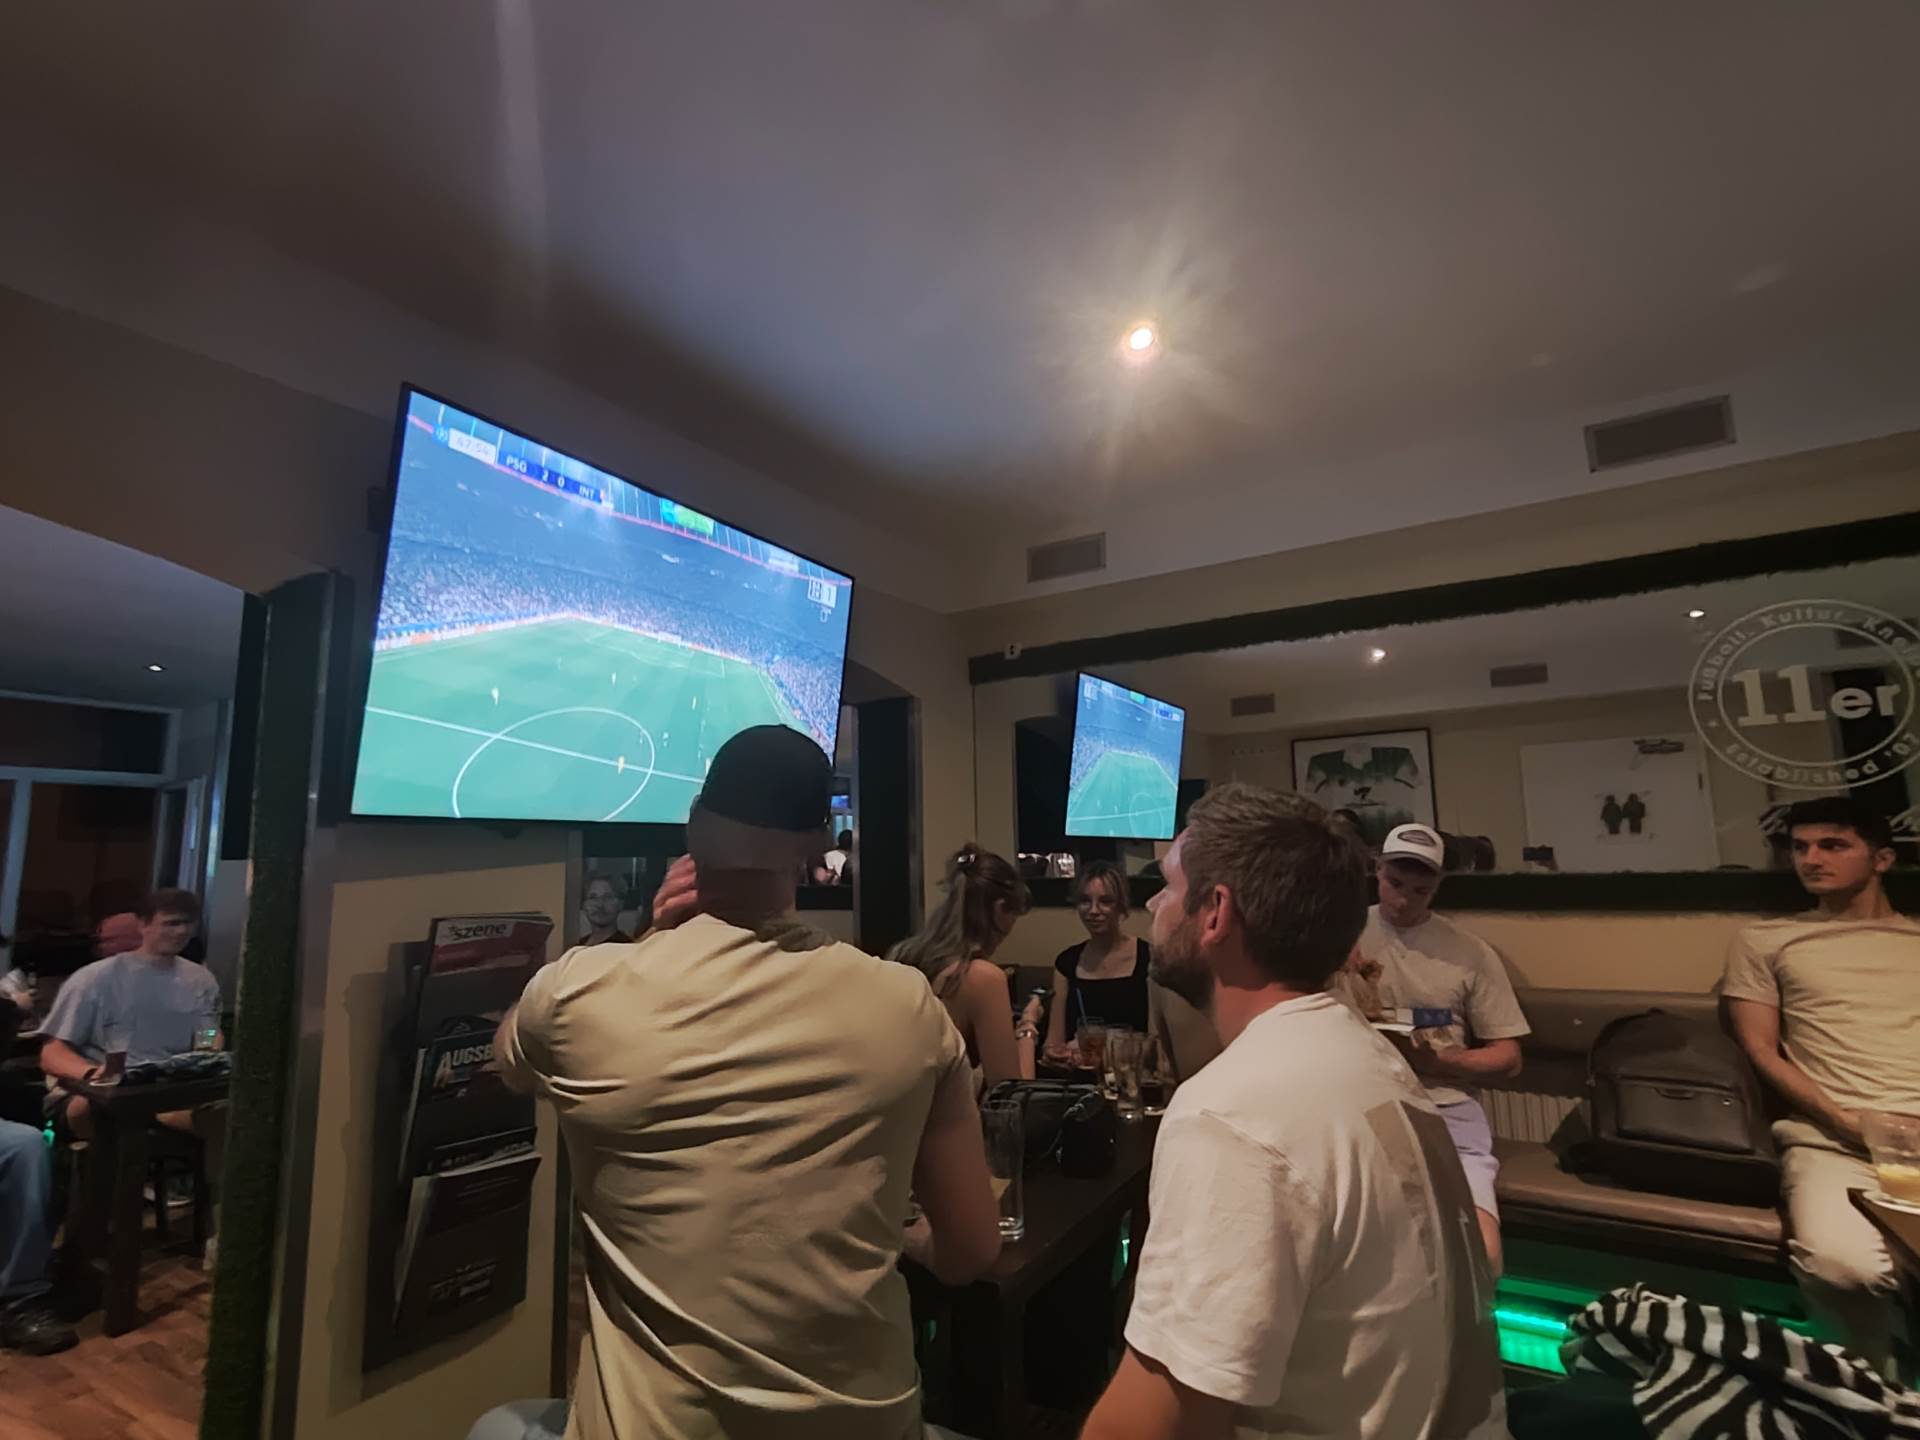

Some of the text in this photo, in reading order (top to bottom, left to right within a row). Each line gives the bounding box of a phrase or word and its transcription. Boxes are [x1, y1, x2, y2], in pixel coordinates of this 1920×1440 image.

[506, 456, 528, 473] PSG
[541, 470, 549, 482] 2
[558, 475, 566, 487] 0
[579, 485, 595, 499] INT
[1731, 664, 1900, 727] 11er
[1726, 744, 1880, 783] Established
